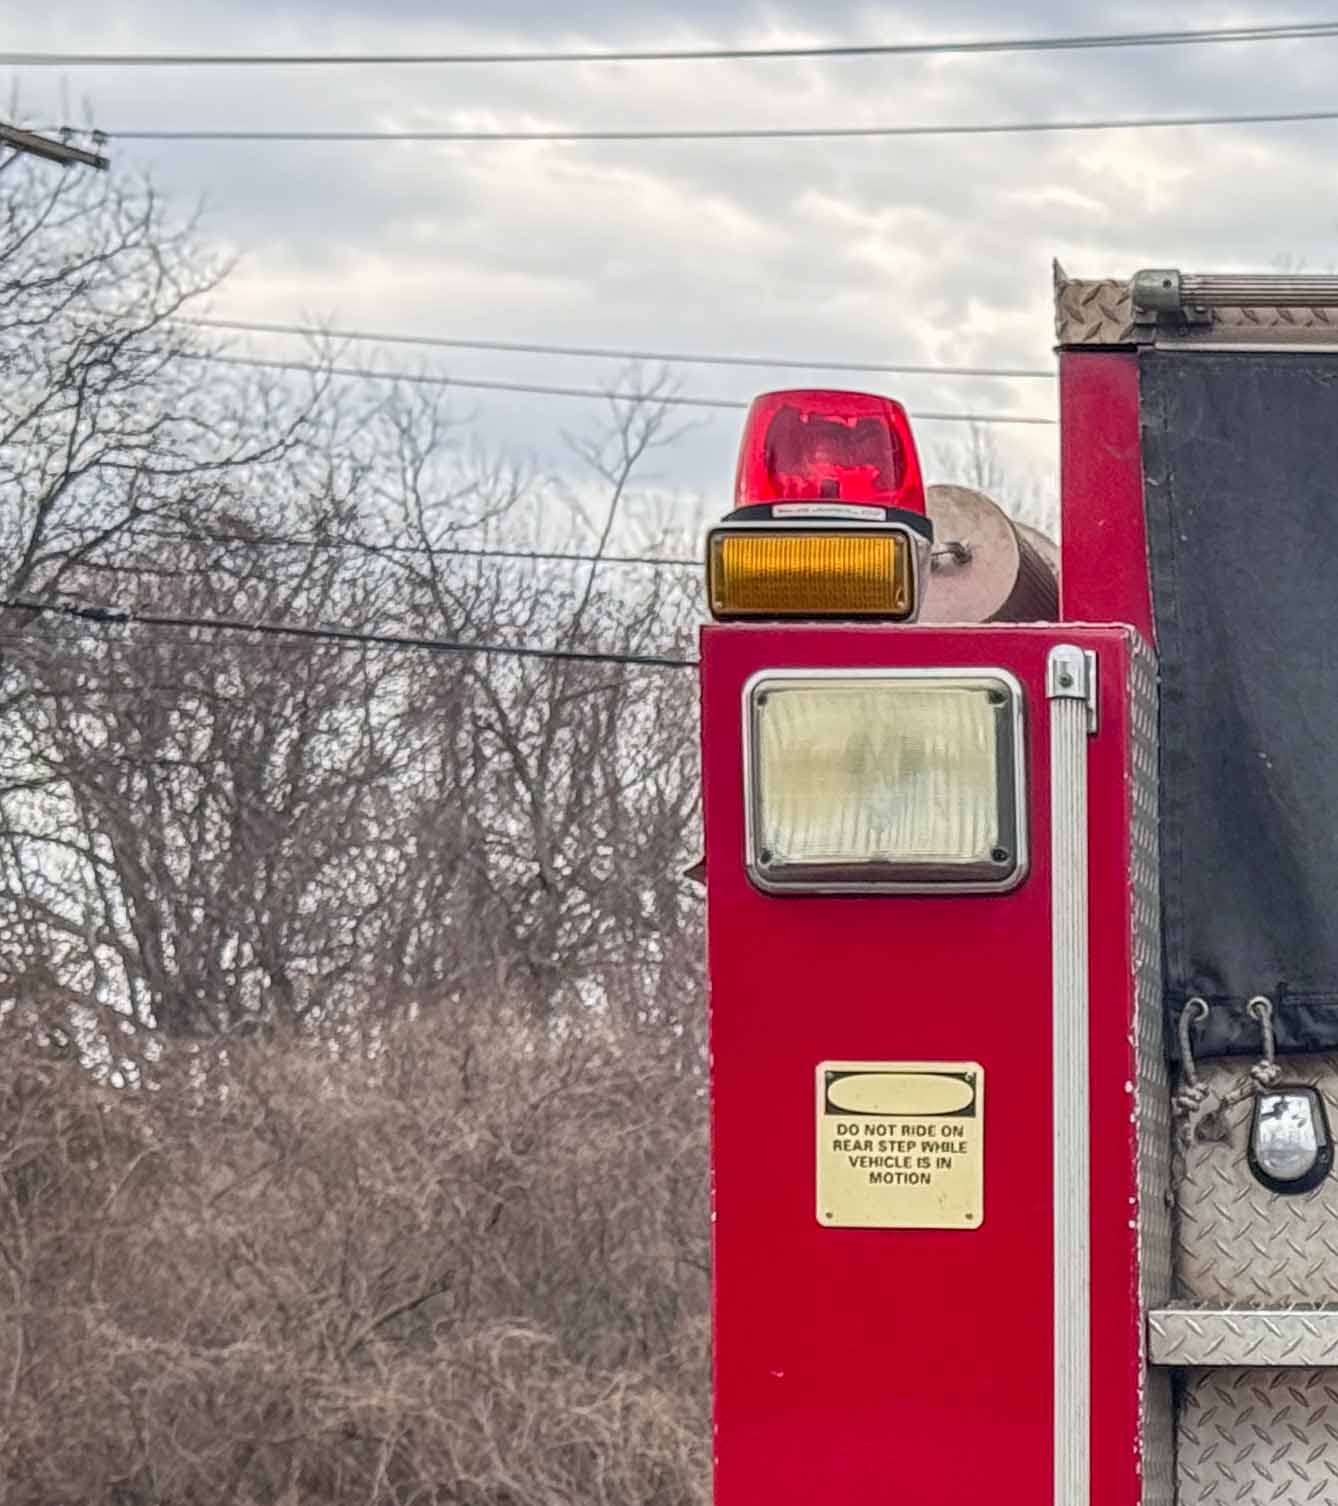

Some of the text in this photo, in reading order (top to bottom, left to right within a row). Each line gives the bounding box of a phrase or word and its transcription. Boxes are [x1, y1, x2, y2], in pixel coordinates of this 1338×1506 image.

[837, 1123, 964, 1138] DO NOT RIDE ON
[833, 1140, 968, 1154] REAR STEP WHILE
[848, 1156, 952, 1169] VEHICLE IS IN
[869, 1172, 931, 1185] MOTION
